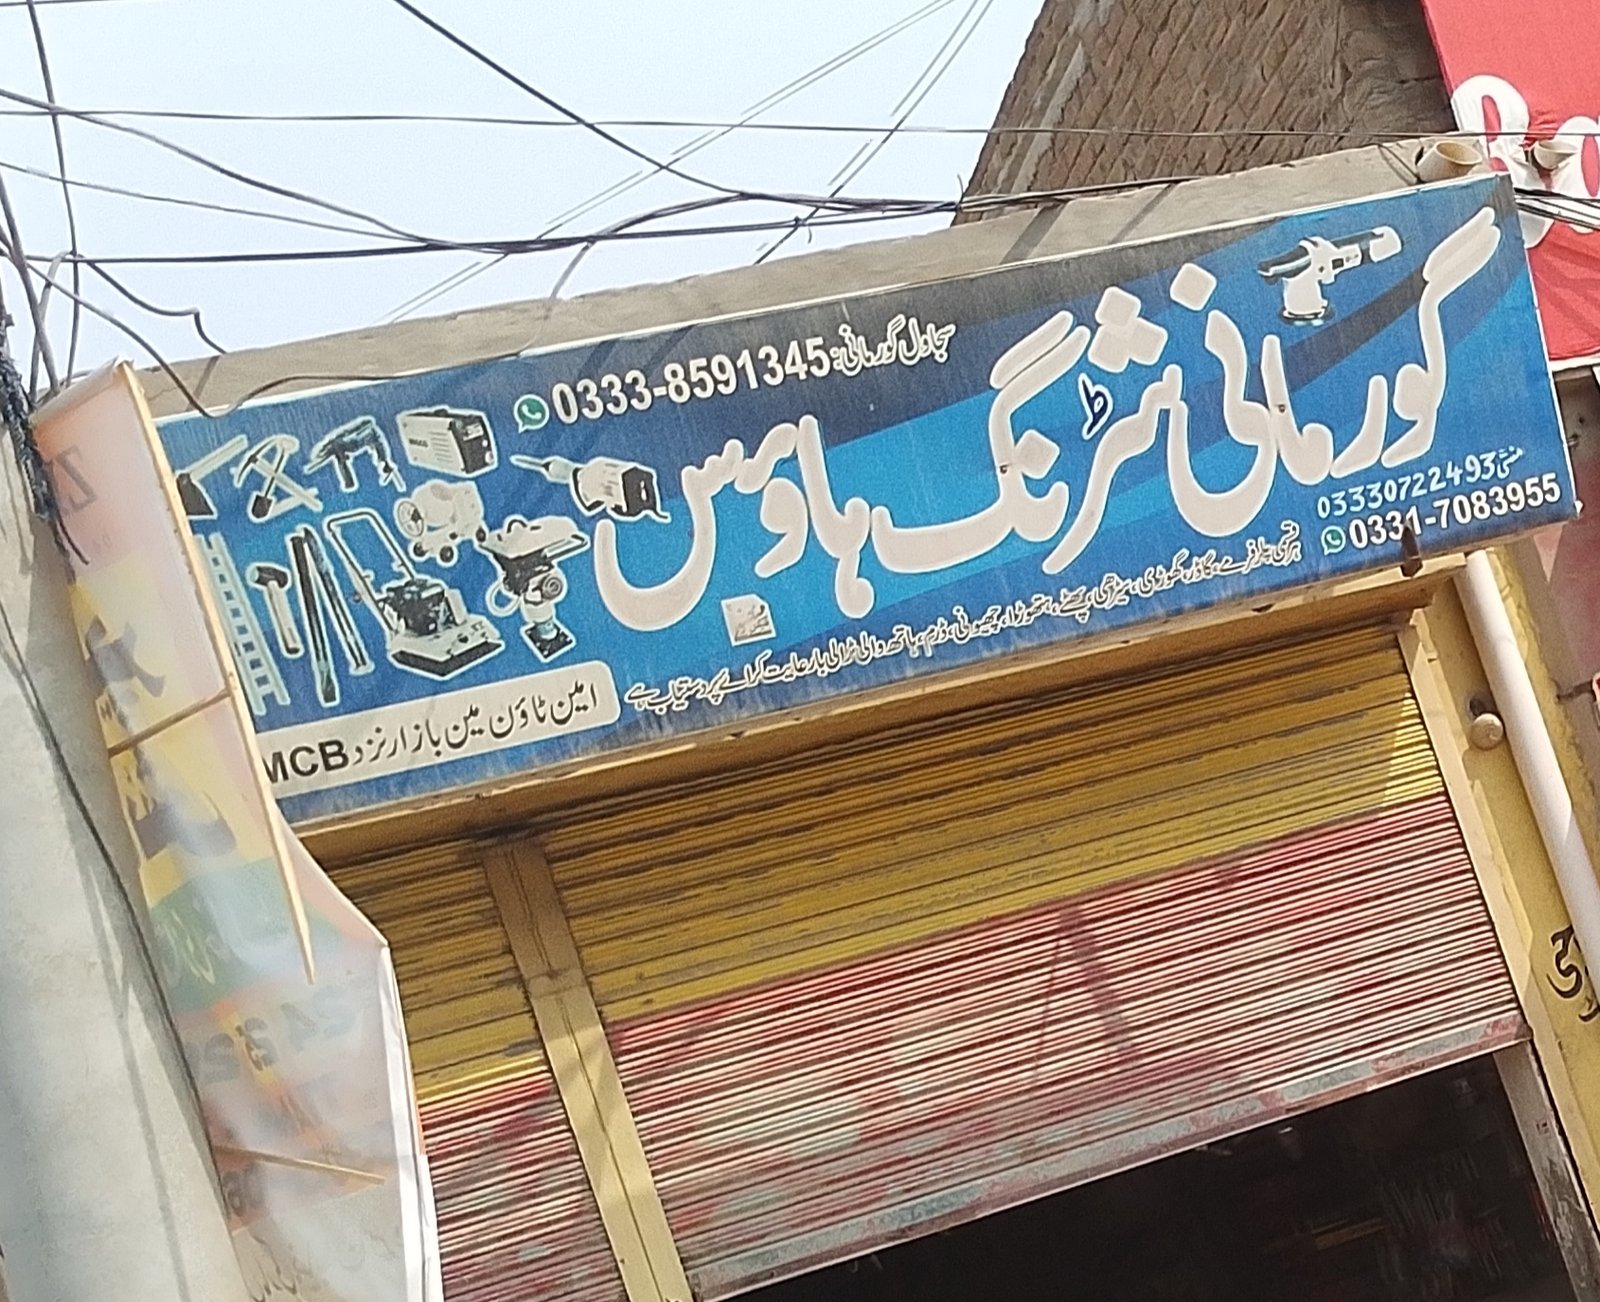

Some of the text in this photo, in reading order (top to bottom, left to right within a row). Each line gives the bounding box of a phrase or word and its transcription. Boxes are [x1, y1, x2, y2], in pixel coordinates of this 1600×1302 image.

[552, 336, 831, 424] 0333-8591345
[1168, 206, 1502, 537] گورمانی
[869, 286, 1183, 574] شٹرنگ
[1317, 451, 1496, 519] 03330722493
[1349, 473, 1561, 549] 0331-7083955
[851, 631, 887, 665] والی
[627, 684, 661, 710] ہے
[647, 679, 710, 716] دستیاب
[706, 669, 731, 705] پر
[262, 680, 597, 784] امین ٹاؤن مین بازار نزد MCB
